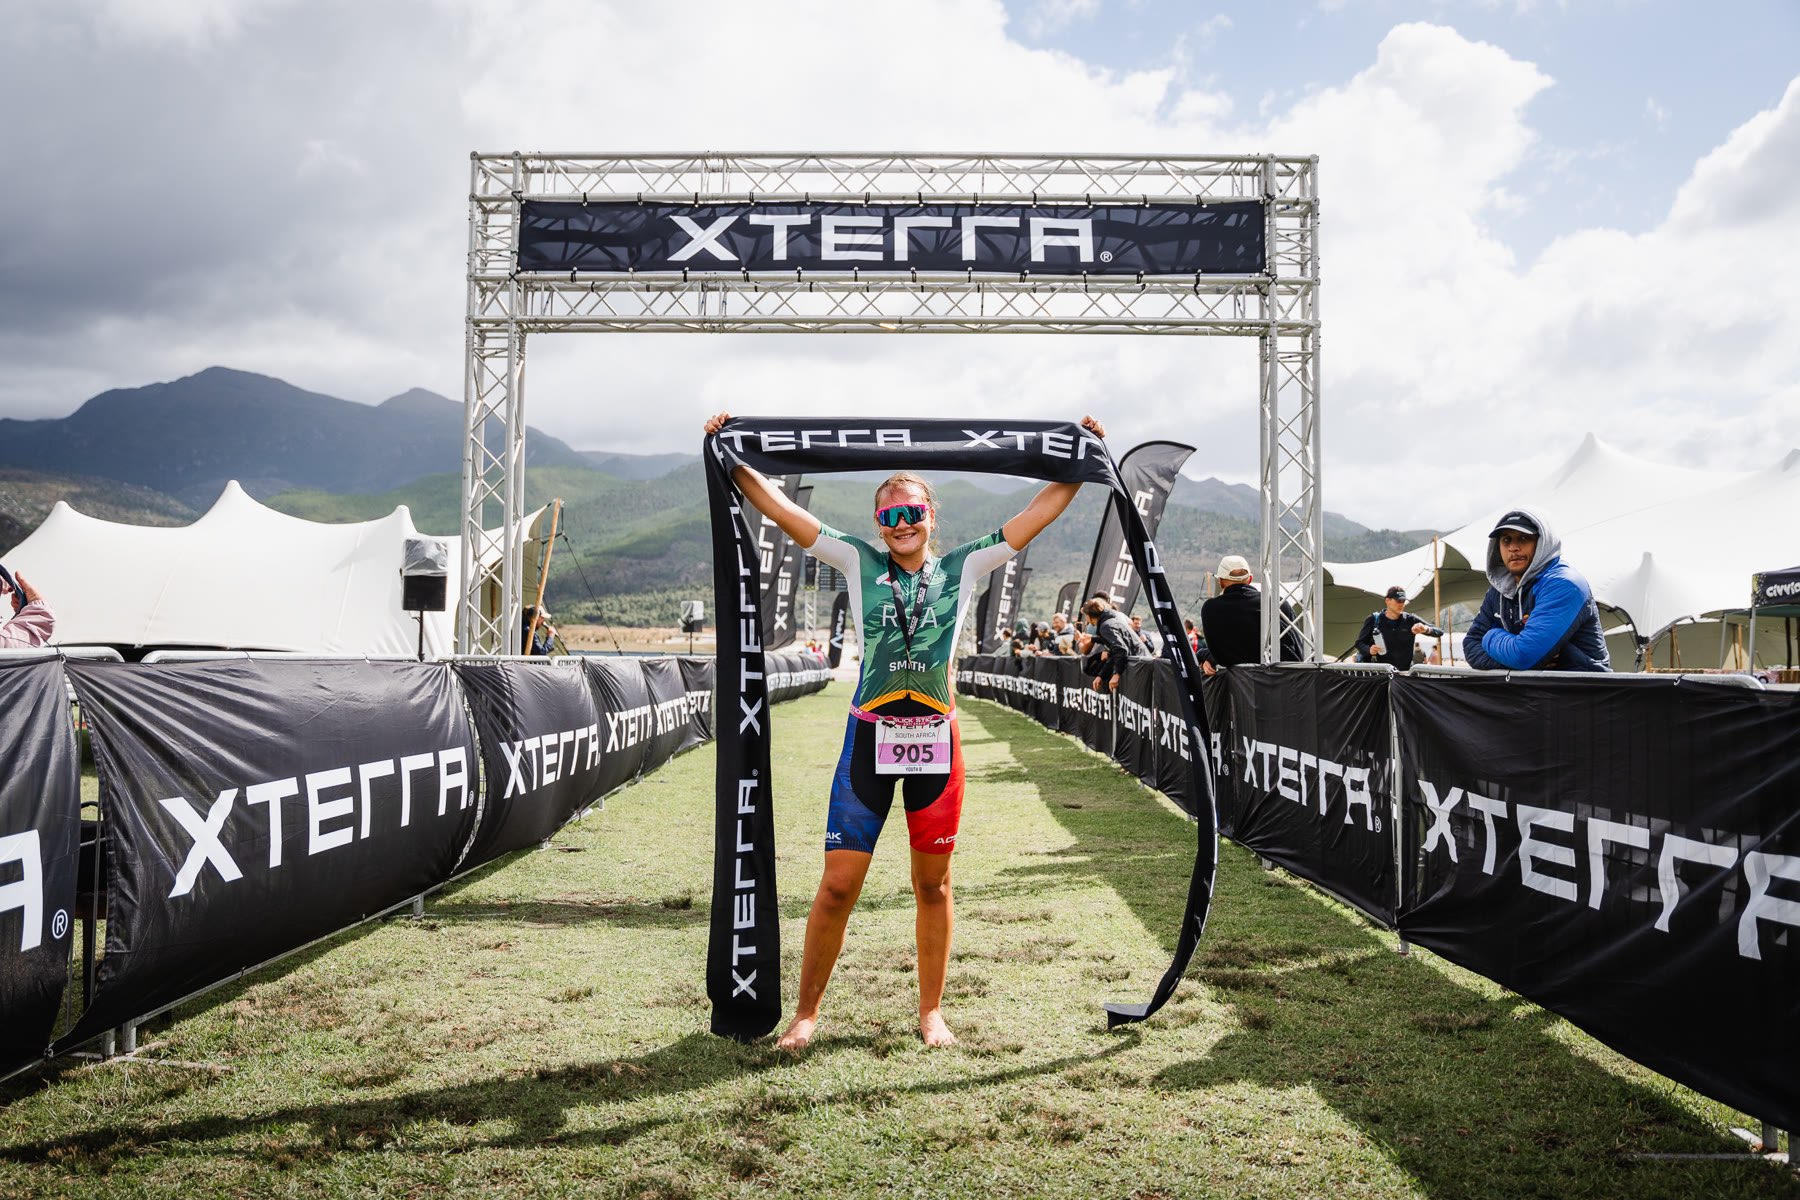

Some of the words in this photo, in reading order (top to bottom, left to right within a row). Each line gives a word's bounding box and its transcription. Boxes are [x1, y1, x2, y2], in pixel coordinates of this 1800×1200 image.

[667, 214, 1094, 262] XTERRA
[712, 429, 911, 454] TERRA
[889, 660, 926, 673] SMITH
[606, 705, 652, 753] XTERRA
[499, 724, 599, 799] XTERRA
[893, 745, 934, 763] 905
[1243, 736, 1373, 831] XTERRA
[159, 746, 468, 899] XTERRA
[732, 778, 759, 1000] XTERRA
